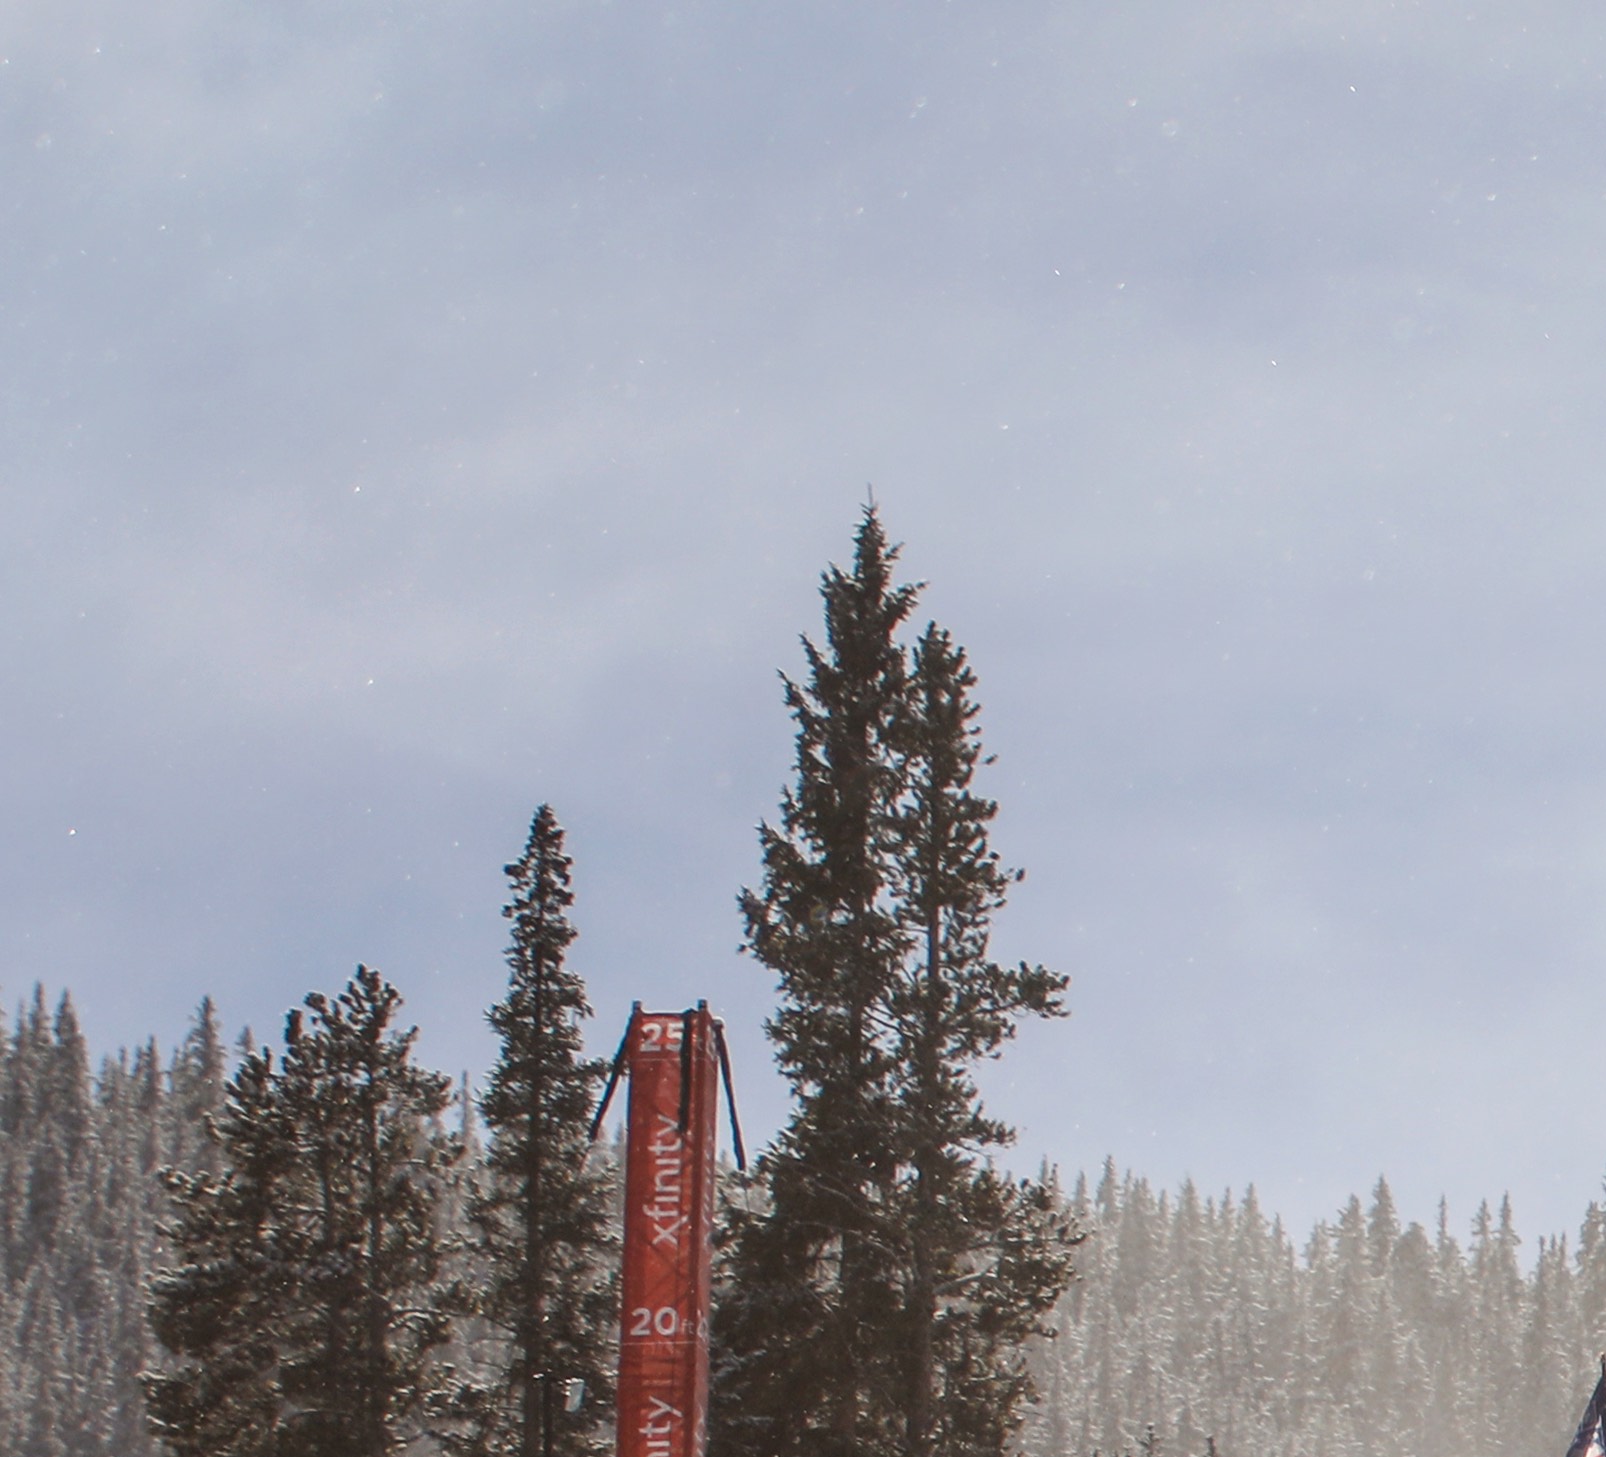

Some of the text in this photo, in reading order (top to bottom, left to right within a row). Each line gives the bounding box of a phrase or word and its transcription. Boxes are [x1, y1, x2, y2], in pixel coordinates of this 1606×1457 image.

[639, 1021, 684, 1053] 25
[643, 1113, 688, 1246] xfinity
[629, 1306, 679, 1337] 20
